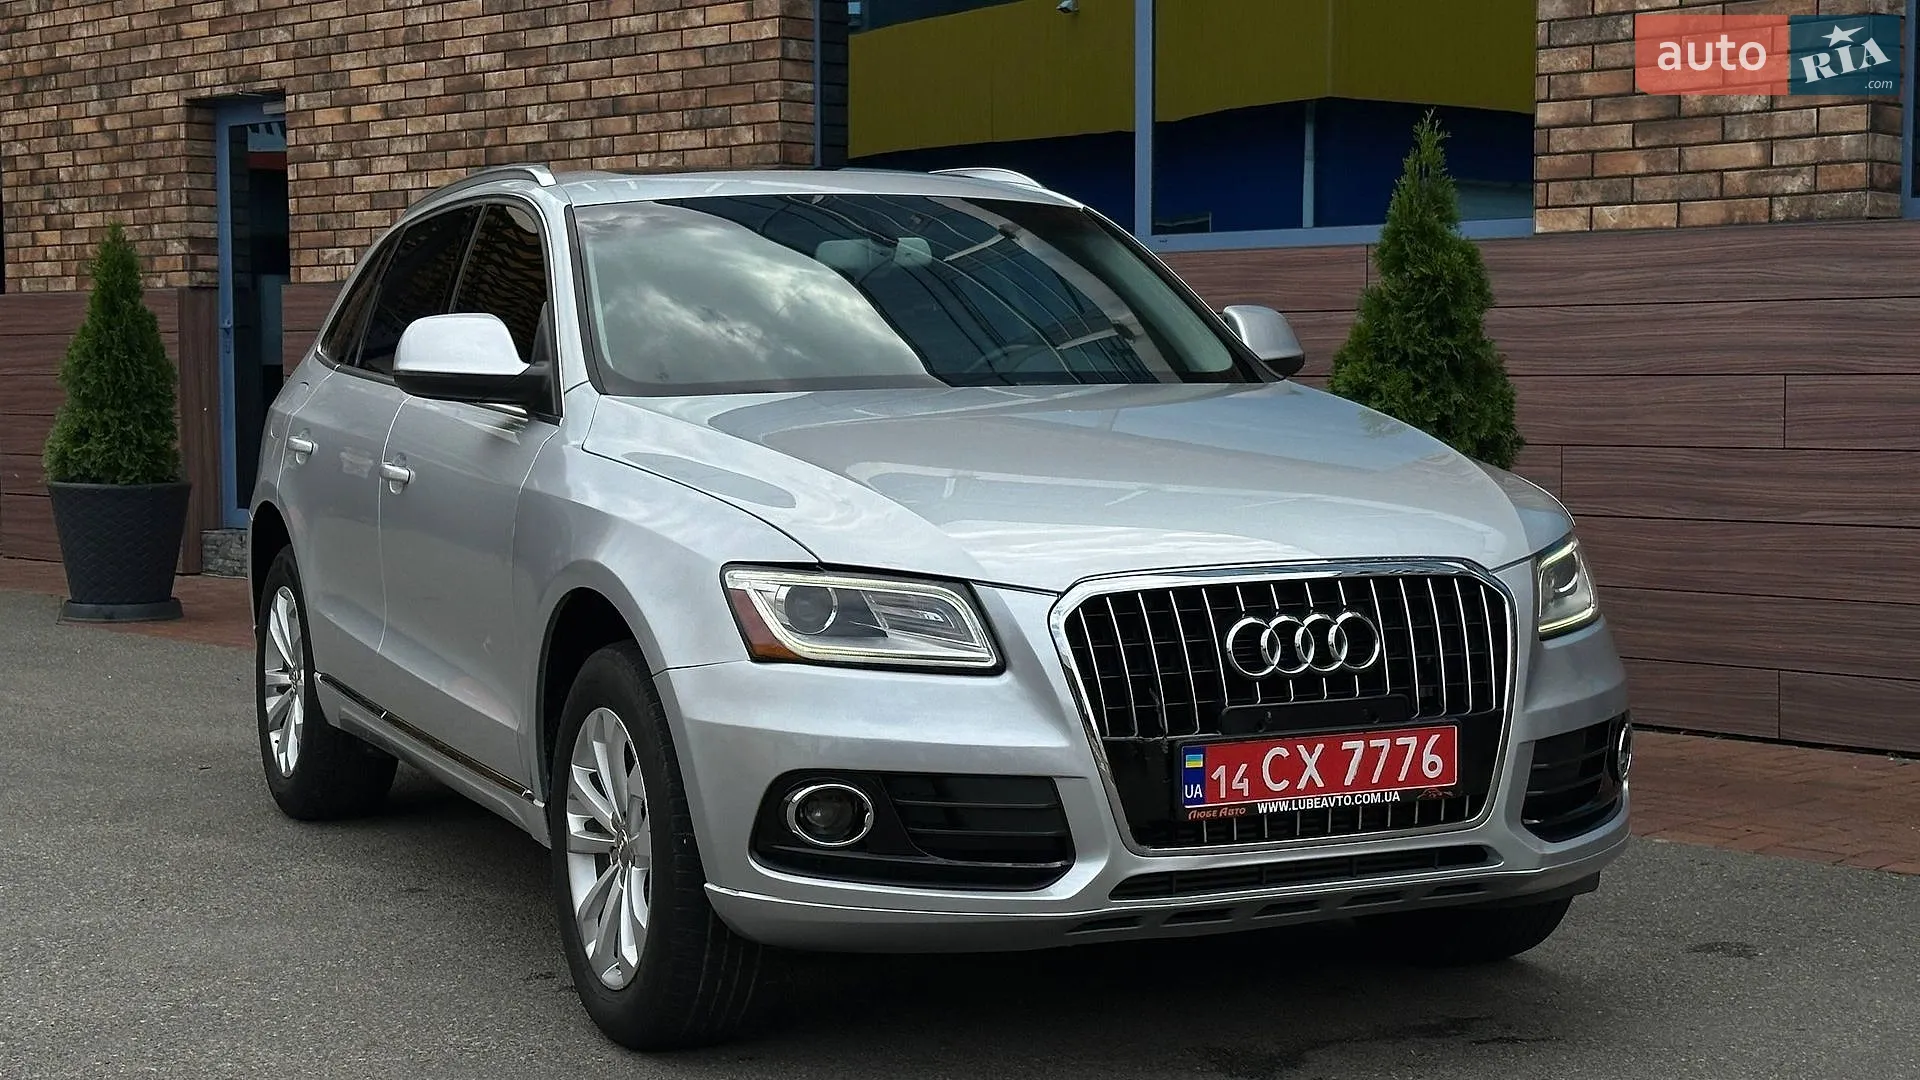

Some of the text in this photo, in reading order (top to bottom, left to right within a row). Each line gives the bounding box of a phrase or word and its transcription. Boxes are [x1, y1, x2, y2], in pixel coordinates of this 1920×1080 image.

[1210, 734, 1444, 799] 14 CX 7776
[1184, 784, 1203, 799] UA
[1256, 790, 1401, 815] WWW.LUBEAVTO.COM.UA
